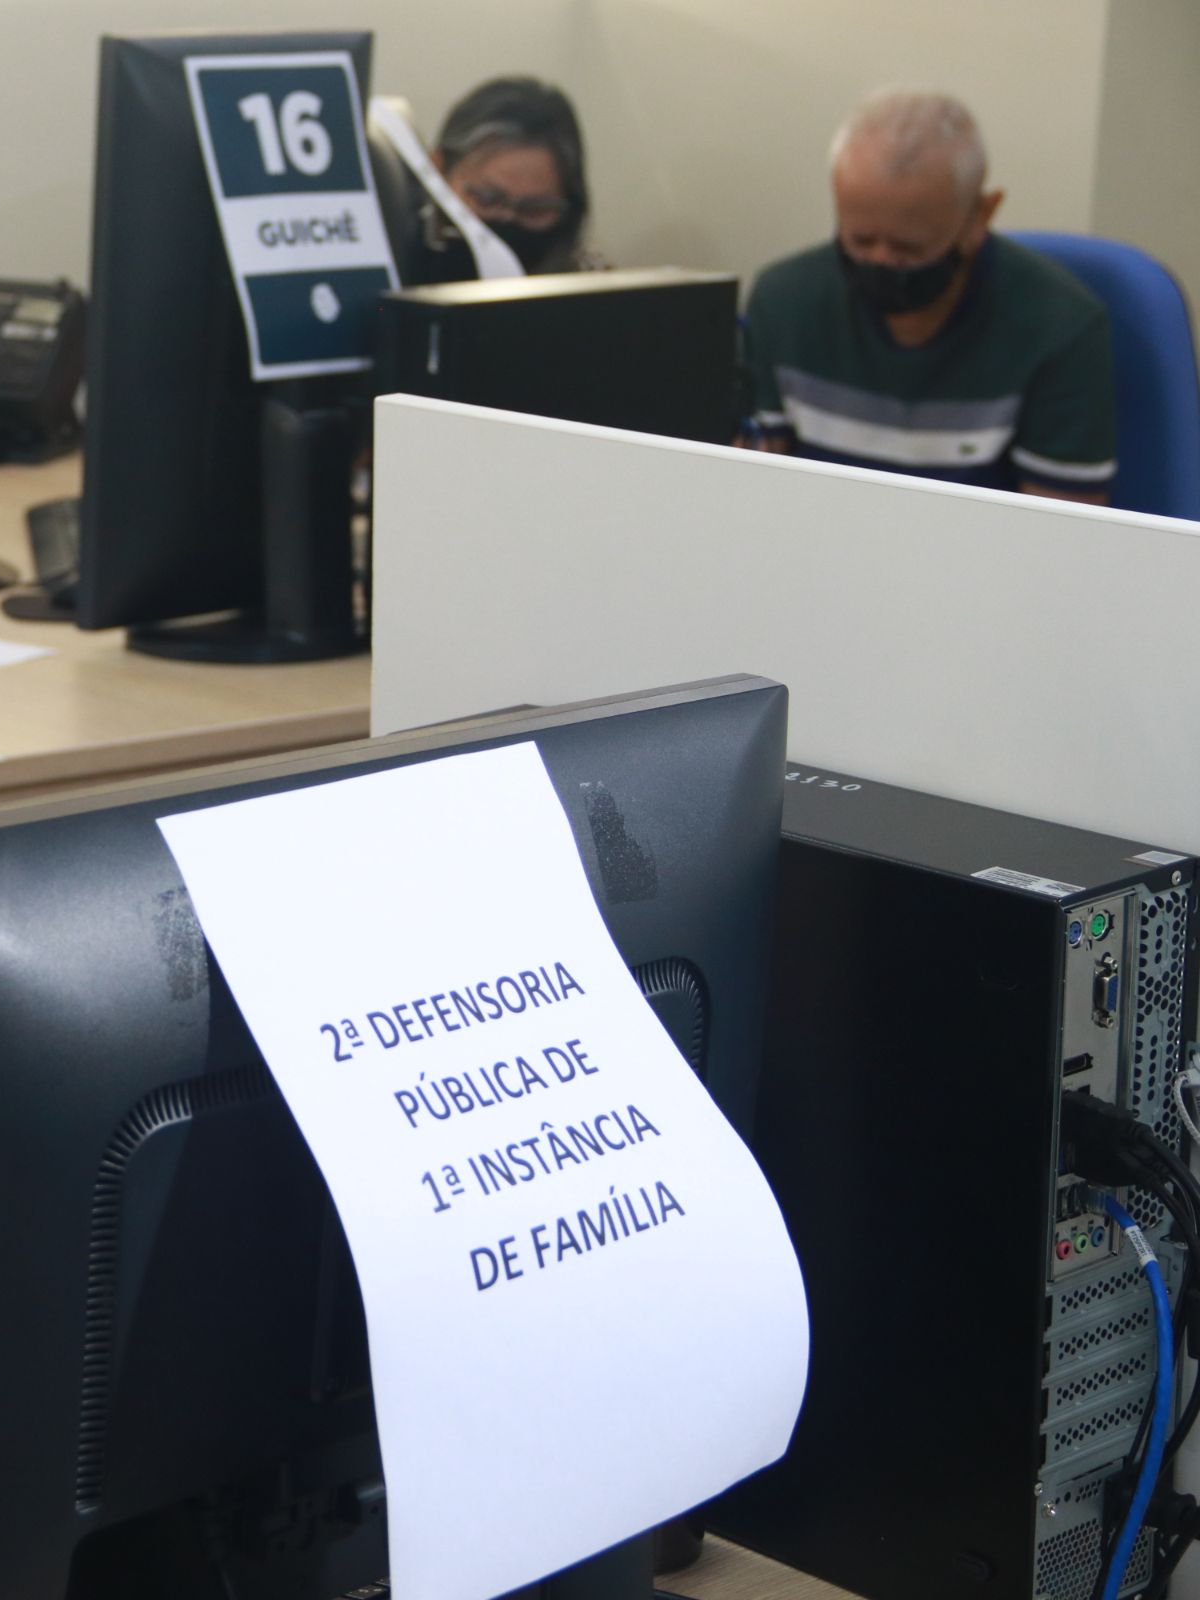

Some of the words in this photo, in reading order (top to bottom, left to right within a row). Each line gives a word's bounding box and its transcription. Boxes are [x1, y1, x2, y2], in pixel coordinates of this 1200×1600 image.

[239, 91, 332, 175] 16
[257, 211, 359, 247] GUICHÊ
[320, 1019, 364, 1063] 2ª
[367, 962, 585, 1049] DEFENSORIA
[394, 1057, 548, 1128] PÚBLICA
[542, 1040, 599, 1083] DE
[422, 1165, 464, 1212] 1ª
[468, 1105, 660, 1195] INSTÂNCIA
[470, 1236, 523, 1291] DE
[531, 1181, 685, 1269] FAMÍLIA
